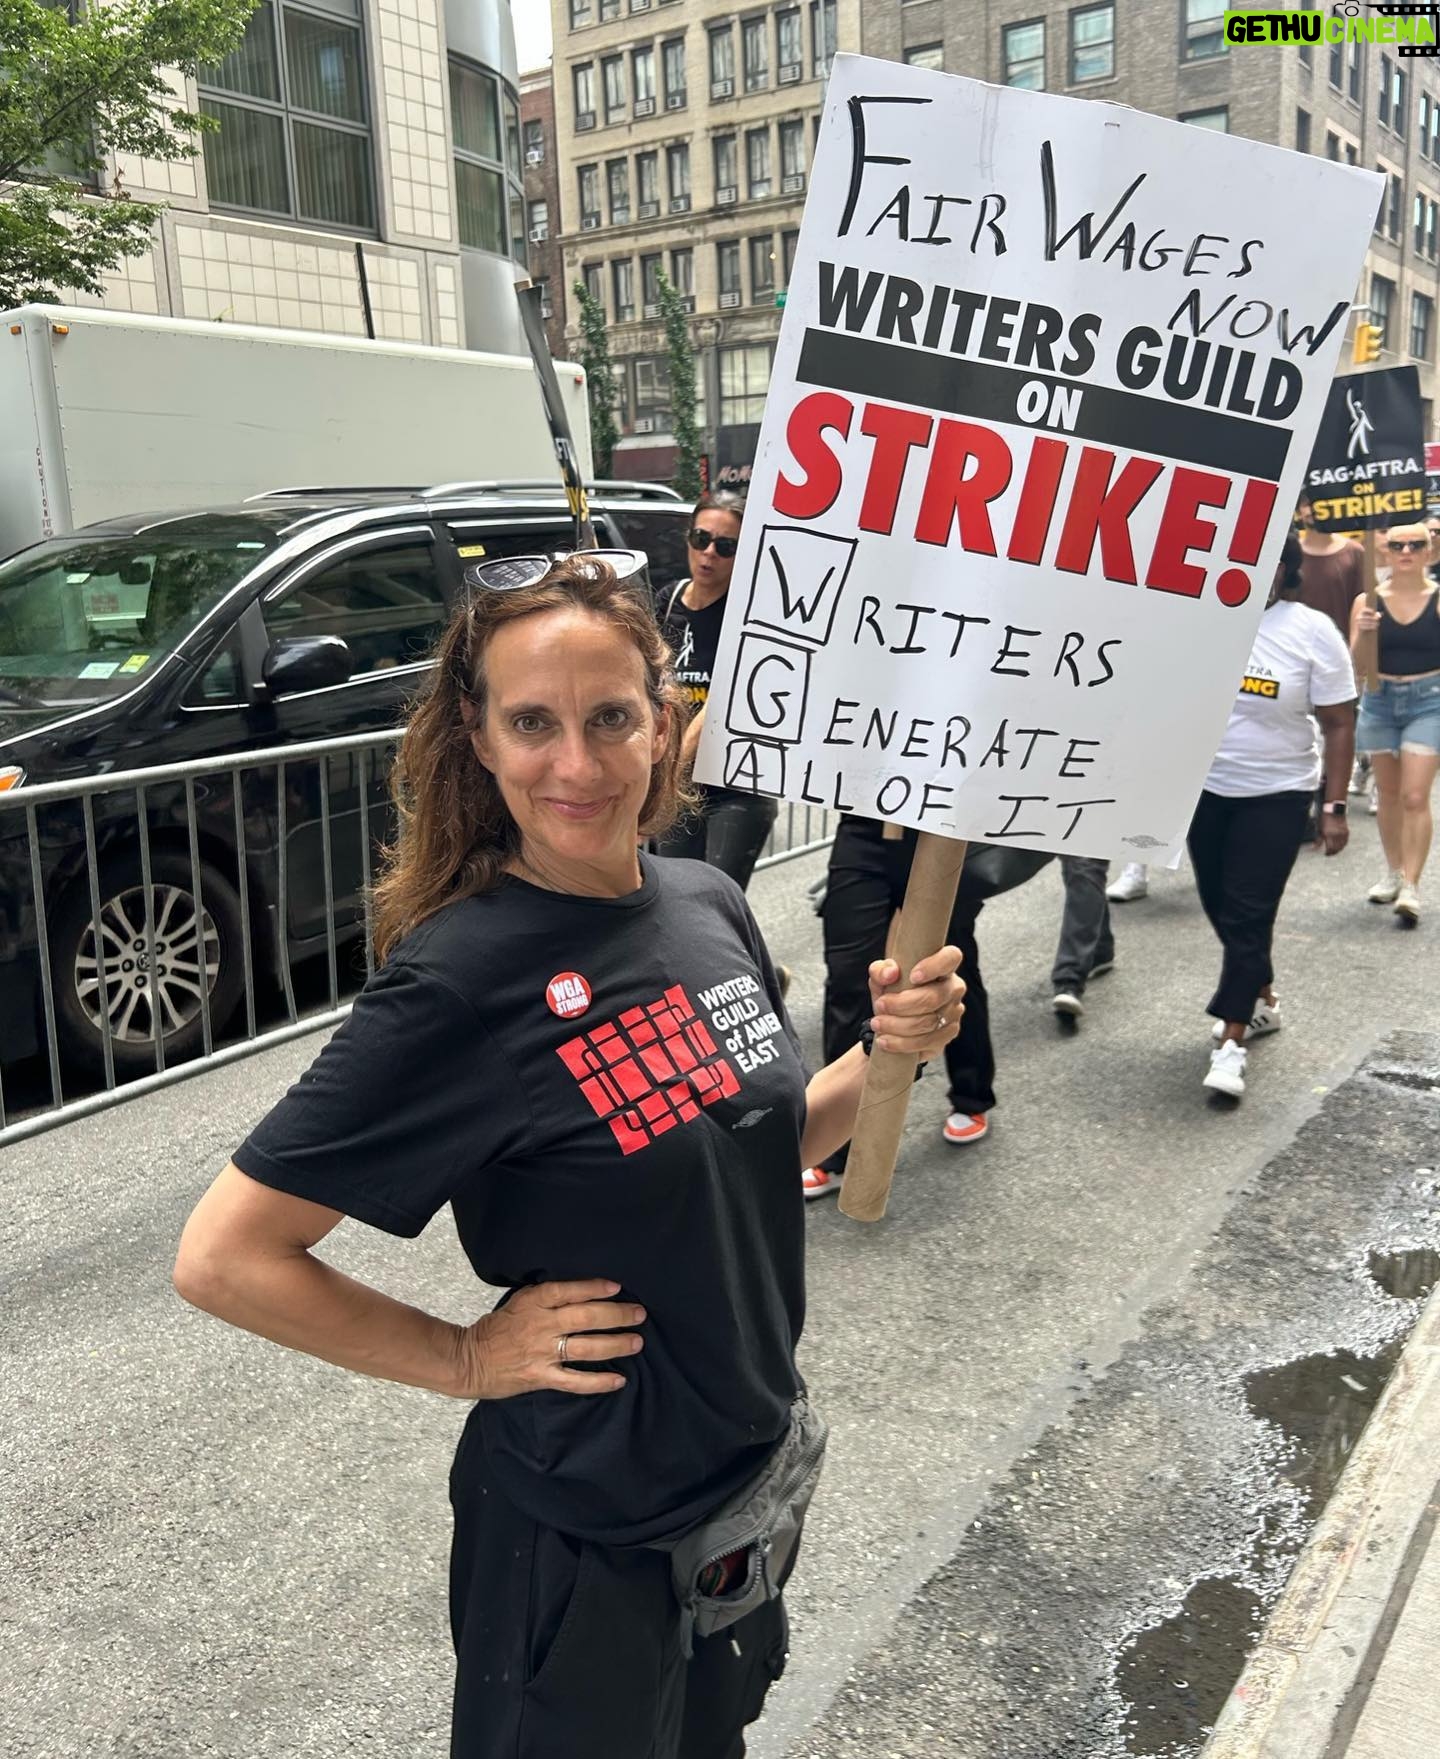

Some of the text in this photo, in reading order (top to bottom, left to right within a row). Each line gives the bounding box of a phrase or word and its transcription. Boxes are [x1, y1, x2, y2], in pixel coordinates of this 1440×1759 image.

[838, 95, 1265, 279] FAIR WAGES
[1167, 288, 1351, 356] NOW
[817, 260, 1304, 421] WRITERS GUILD
[1015, 379, 1084, 432] ON
[772, 391, 1279, 607] STRIKE!
[1312, 489, 1424, 521] STRIKE!
[1353, 482, 1376, 495] ON
[984, 795, 1117, 840] IT
[550, 976, 586, 1002] WGA
[555, 994, 589, 1015] STRONG
[697, 974, 760, 1011] WRITERS
[711, 998, 760, 1032] GUILD
[725, 1028, 745, 1053] of
[734, 1038, 780, 1074] EAST
